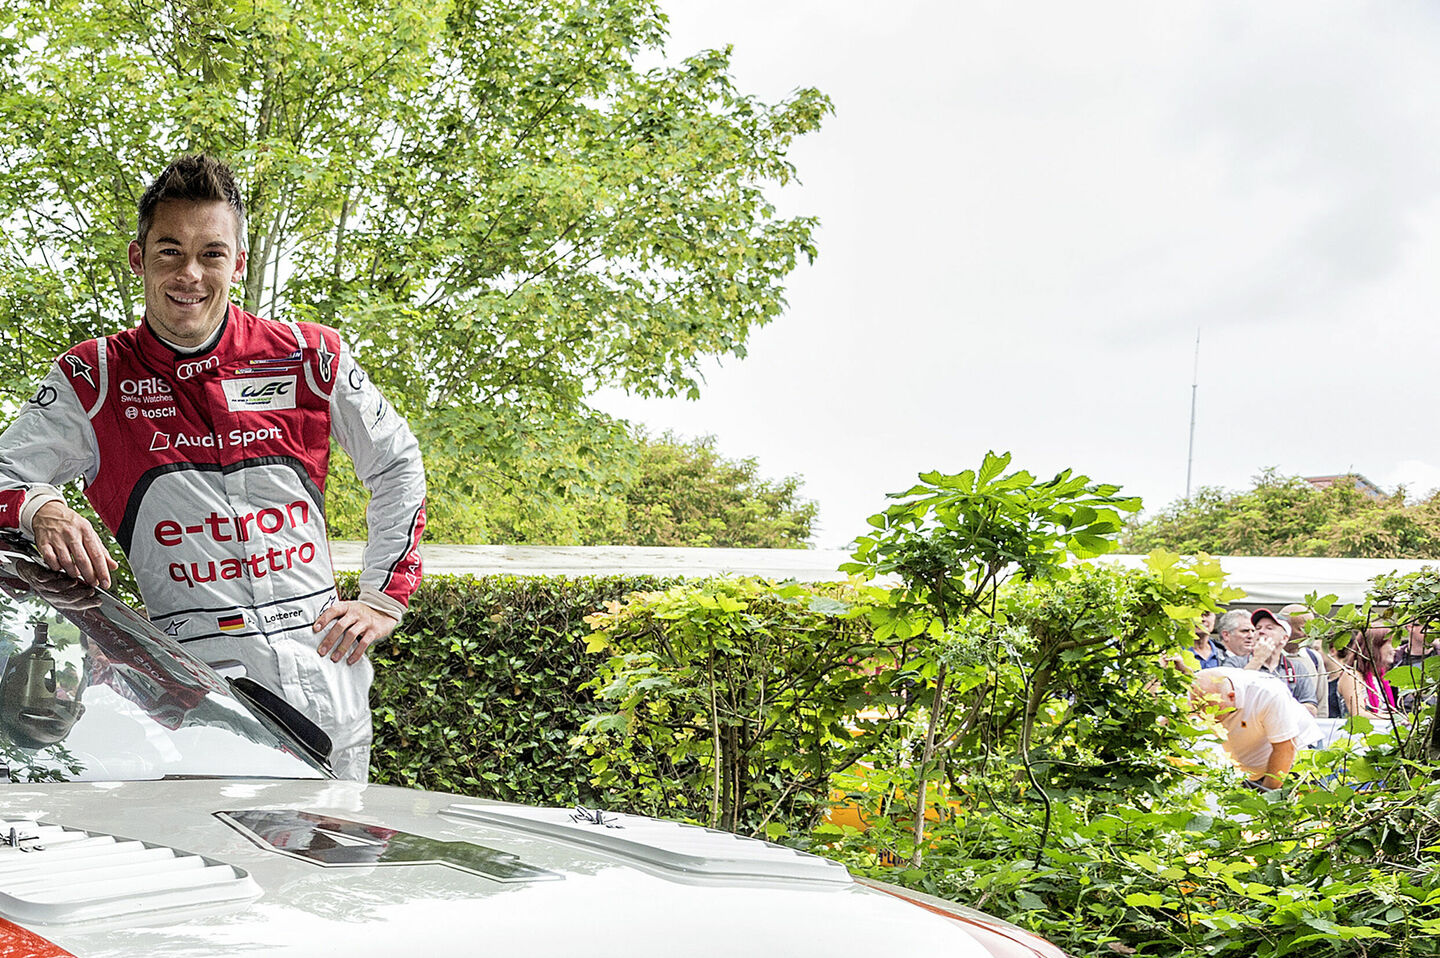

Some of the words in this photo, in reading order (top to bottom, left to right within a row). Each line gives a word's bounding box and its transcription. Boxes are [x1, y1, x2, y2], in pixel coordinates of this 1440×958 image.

[120, 377, 172, 396] ORIS
[241, 381, 293, 398] WEC
[121, 394, 142, 403] Swiss
[142, 393, 174, 404] Watches
[141, 406, 177, 419] BOSCH
[174, 432, 224, 450] Audi
[228, 425, 283, 447] Sport
[154, 500, 310, 547] e-tron
[168, 541, 316, 589] quattro
[264, 609, 304, 624] Lotterer
